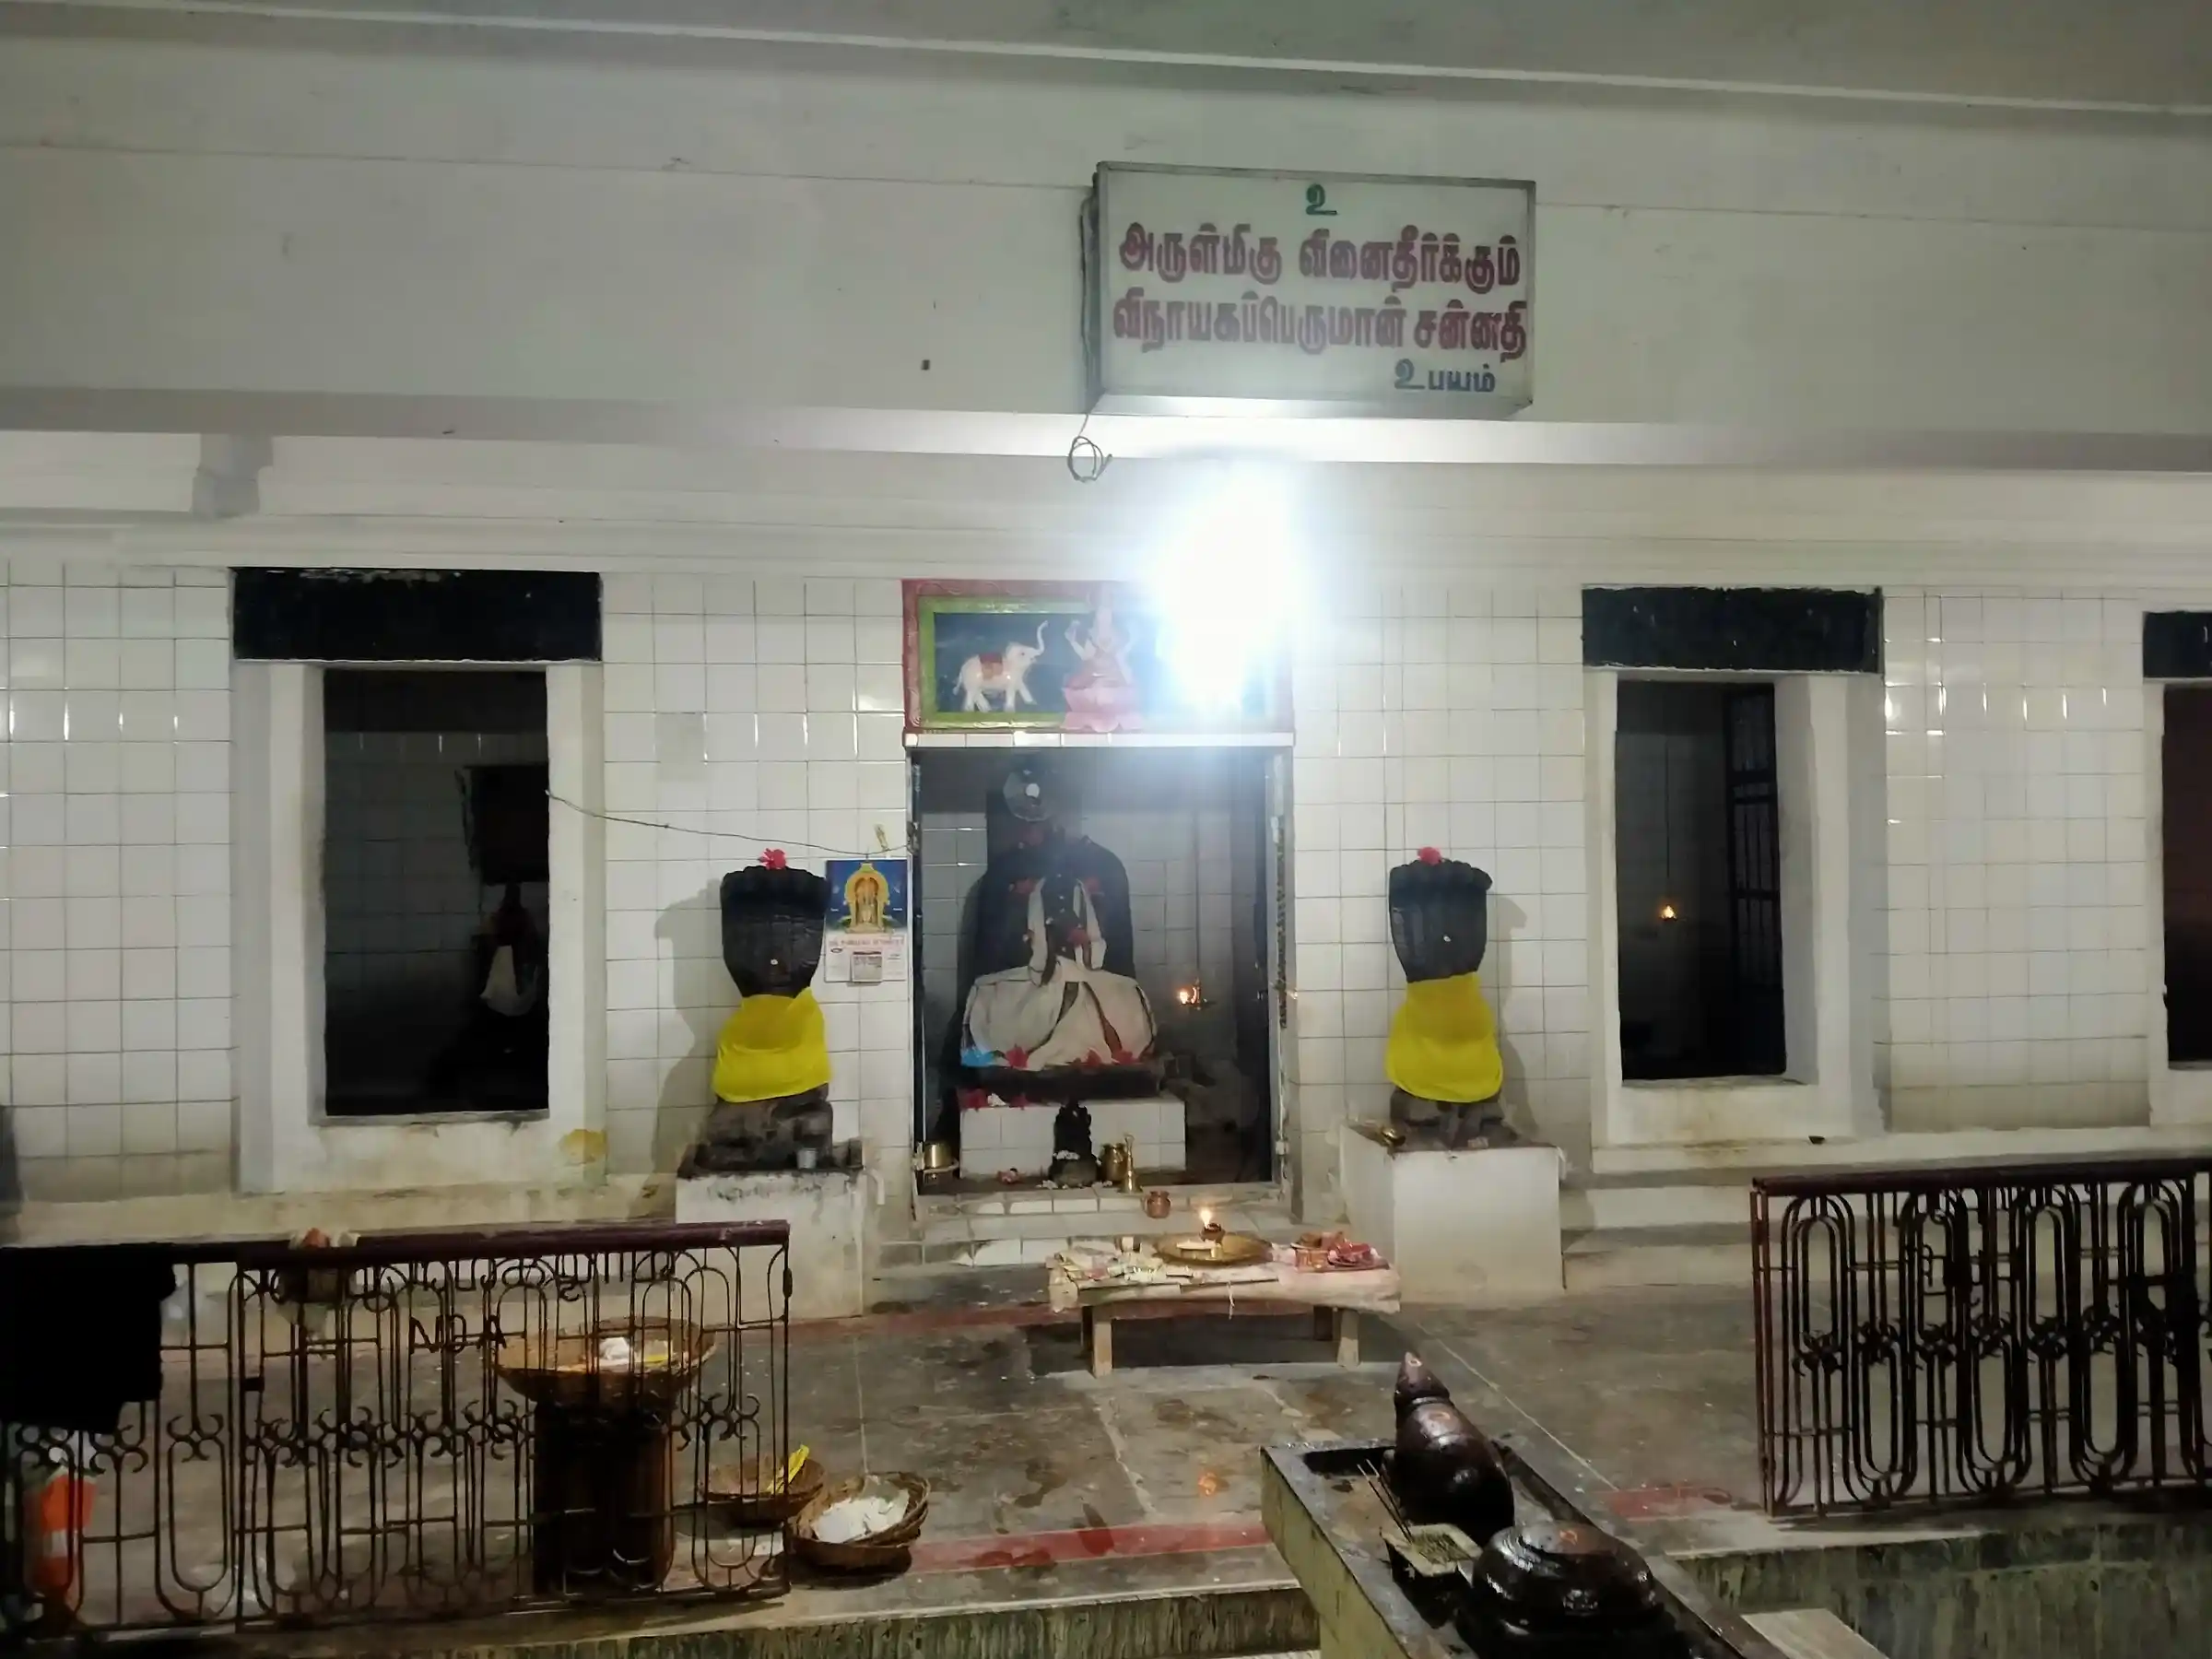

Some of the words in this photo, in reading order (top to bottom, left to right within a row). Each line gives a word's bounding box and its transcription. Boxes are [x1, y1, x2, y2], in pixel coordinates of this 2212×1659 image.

[1119, 222, 1283, 285] அருள்மிகு
[1298, 224, 1522, 295] வினைதீர்க்கும்
[1112, 286, 1407, 355] விநாயகப்பெருமான்
[1413, 299, 1528, 363] சன்னதி
